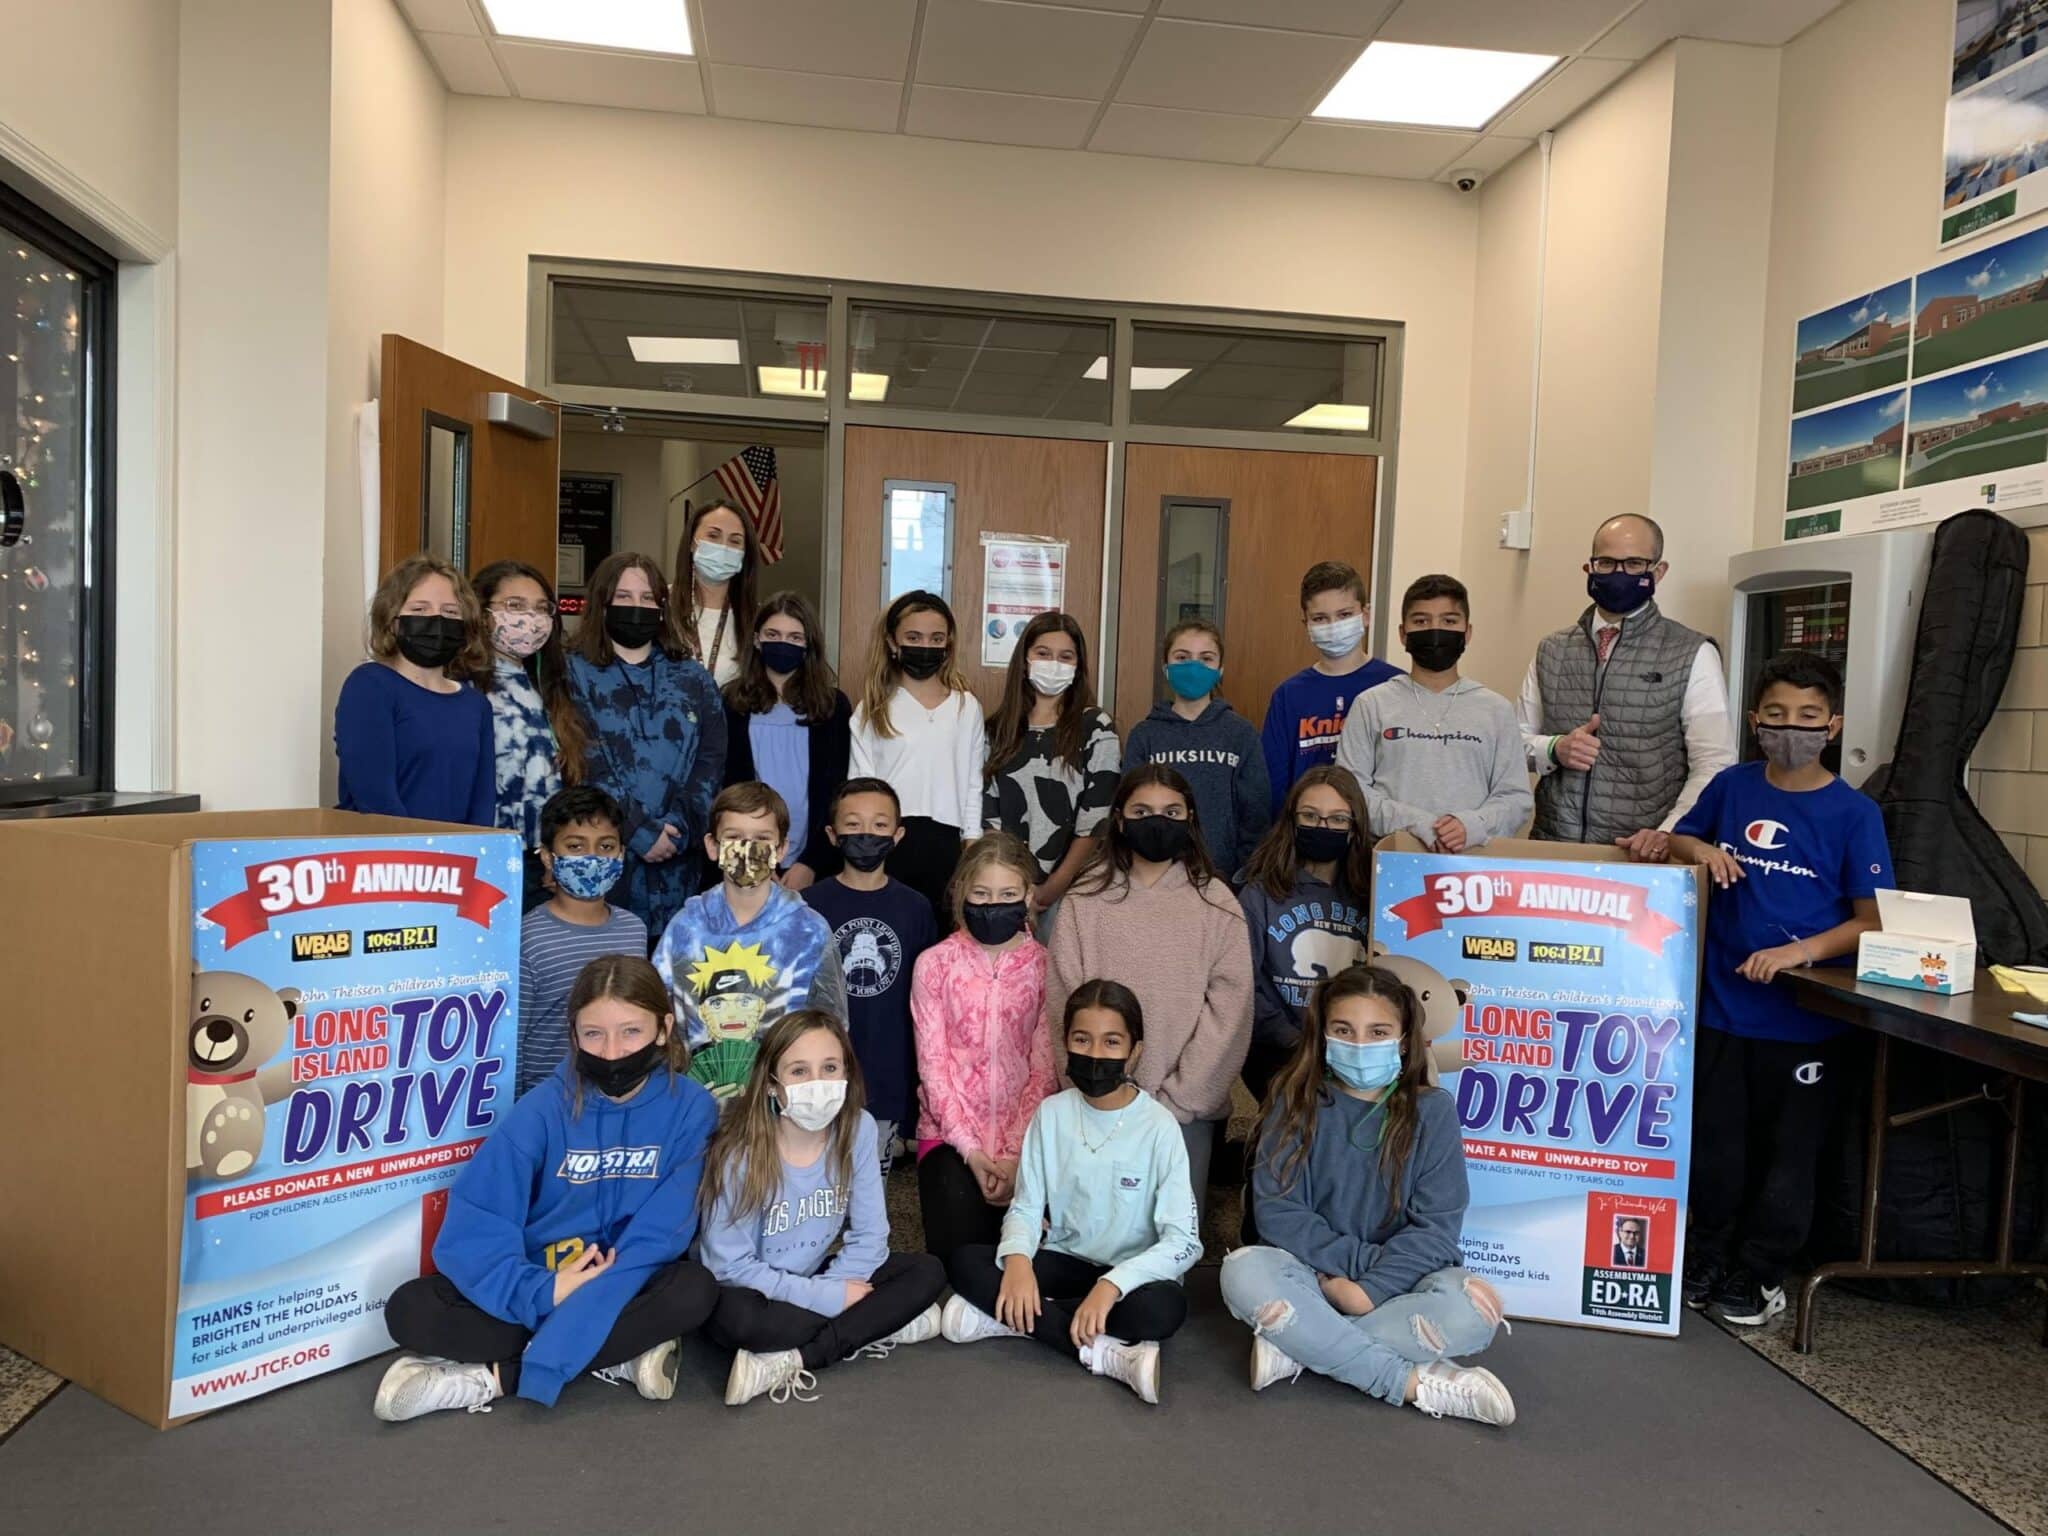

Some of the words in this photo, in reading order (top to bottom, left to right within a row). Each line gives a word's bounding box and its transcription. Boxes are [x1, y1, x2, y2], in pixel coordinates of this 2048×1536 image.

[1383, 726, 1482, 746] Champion
[257, 859, 345, 912] 30th
[352, 863, 463, 896] ANNUAL
[1434, 874, 1512, 915] 30th
[1518, 882, 1633, 921] ANNUAL
[401, 927, 435, 946] BLI
[1268, 902, 1324, 943] LONG
[1313, 920, 1330, 929] NEW
[1332, 922, 1353, 933] YORK
[294, 932, 350, 956] WBAB
[1464, 936, 1516, 958] WBAB
[1567, 944, 1602, 963] BLI
[295, 989, 327, 1004] John
[331, 983, 383, 999] Theissen
[387, 975, 443, 992] Children's
[447, 969, 508, 986] Foundation
[1465, 983, 1494, 997] John
[1499, 986, 1547, 1001] Theissen
[1551, 989, 1611, 1007] Children's
[1614, 994, 1685, 1010] Foundation
[293, 1004, 388, 1050] LONG
[390, 989, 506, 1071] TOY
[1463, 1003, 1553, 1040] LONG
[1462, 1038, 1553, 1067] ISLAND
[1555, 1009, 1681, 1081] TOY
[291, 1045, 388, 1083] ISLAND
[282, 1058, 501, 1165] DRIVE
[1456, 1066, 1676, 1149] DRIVE
[223, 1189, 271, 1209] PLEASE
[274, 1176, 329, 1197] DONATE
[332, 1173, 343, 1185] A
[346, 1166, 374, 1182] NEW
[381, 1151, 453, 1175] UNWRAPPED
[455, 1144, 477, 1157] TOY
[1465, 1162, 1488, 1171] DREN
[1489, 1164, 1512, 1175] AGES
[1514, 1167, 1546, 1179] INFANT
[1549, 1171, 1561, 1181] TO
[1564, 1172, 1574, 1182] 17
[1575, 1174, 1603, 1186] YEARS
[1605, 1178, 1625, 1188] OLD
[1499, 1147, 1508, 1158] A
[1511, 1148, 1539, 1161] NEW
[1545, 1152, 1620, 1171] UNWRAPPED
[1623, 1160, 1648, 1173] TOY
[250, 1209, 270, 1221] FOR
[271, 1200, 320, 1218] CHILDREN
[323, 1194, 348, 1206] AGES
[349, 1184, 383, 1200] INFANT
[385, 1181, 397, 1191] TO
[400, 1178, 409, 1188] 17
[411, 1172, 438, 1187] YEARS
[440, 1168, 457, 1180] OLD
[1463, 1250, 1521, 1265] HOLIDAYS
[1492, 1242, 1505, 1250] us
[1528, 1270, 1551, 1281] kids
[1593, 1269, 1657, 1283] ASSEMBLYMAN
[192, 1302, 253, 1331] THANKS
[257, 1300, 274, 1312] for
[278, 1286, 324, 1308] helping
[327, 1281, 341, 1293] us
[1591, 1280, 1620, 1305] ED
[1627, 1283, 1660, 1308] RA
[191, 1351, 211, 1365] for
[214, 1341, 237, 1358] sick
[241, 1332, 264, 1350] and
[267, 1305, 362, 1342] underprivileged
[365, 1297, 388, 1314] kids
[192, 1317, 261, 1348] BRIGHTEN
[264, 1308, 290, 1325] THE
[294, 1290, 358, 1316] HOLIDAYS
[1639, 1312, 1663, 1322] District
[191, 1343, 331, 1398] WWW.JTCF.ORG
